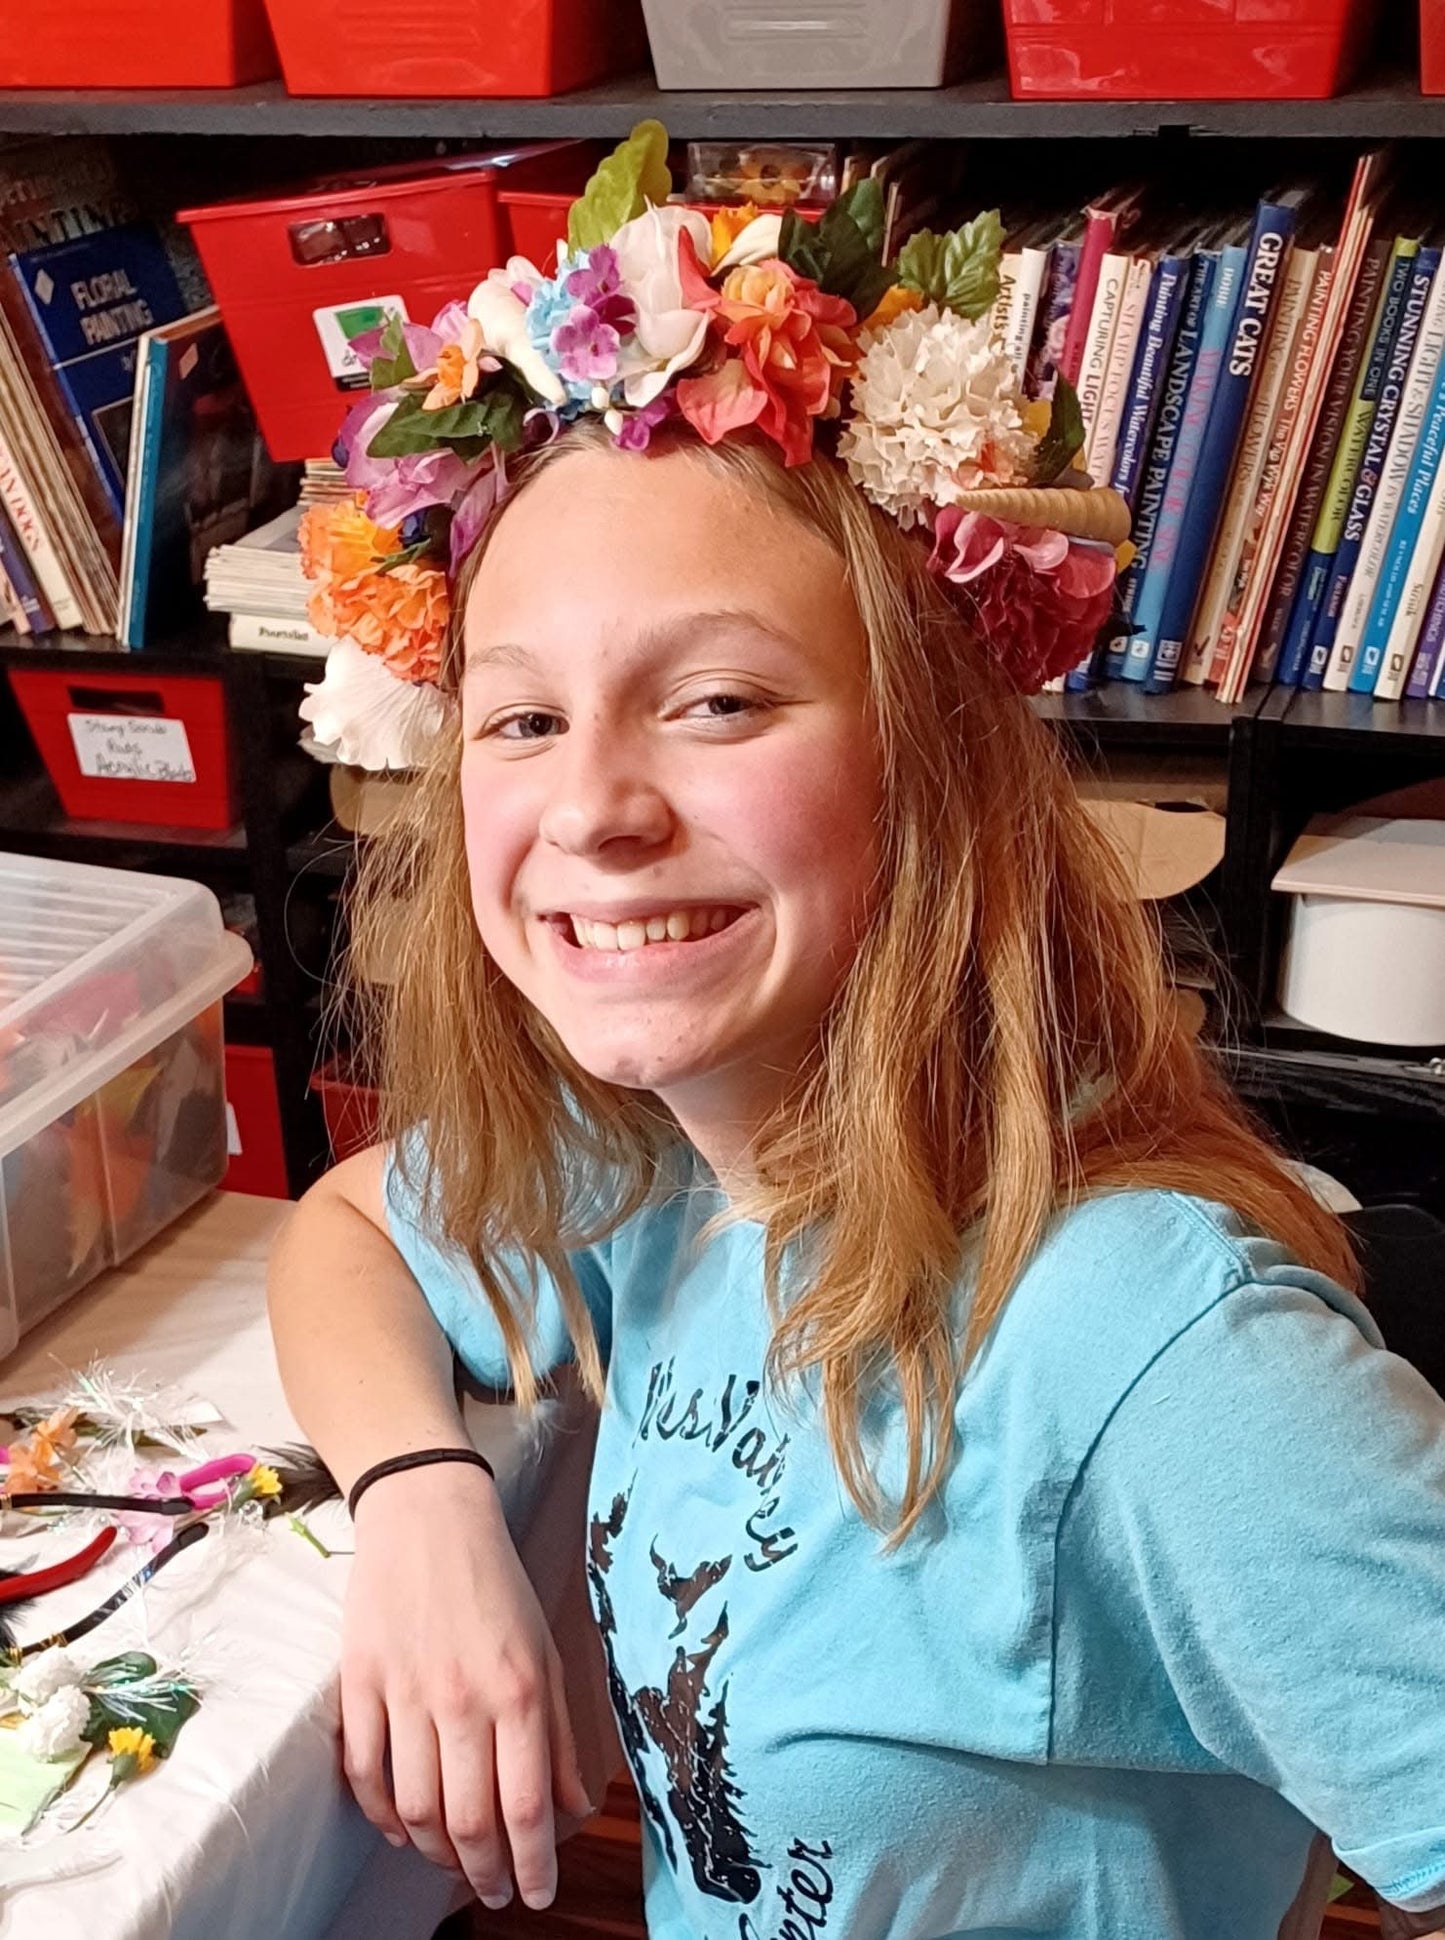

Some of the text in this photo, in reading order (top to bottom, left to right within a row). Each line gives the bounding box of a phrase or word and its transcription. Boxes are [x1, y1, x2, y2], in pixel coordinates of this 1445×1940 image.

[70, 269, 137, 311] FLORAL
[1015, 293, 1031, 342] painting
[1150, 272, 1177, 332] Painting
[1217, 268, 1235, 309] DOBIE
[1229, 233, 1283, 376] GREAT CATS
[1268, 279, 1302, 361] PAINTING
[1303, 270, 1333, 341] PAINTING
[1347, 258, 1381, 343] PAINTING
[80, 298, 154, 345] PAINTING
[1082, 278, 1119, 423] CAPTURING LIGHT
[1114, 304, 1136, 367] SHARP
[1389, 275, 1429, 381] STUNNING
[1136, 335, 1163, 401] Beautiful
[1284, 345, 1313, 412] FLOWERS
[1335, 349, 1357, 395] YOUR
[1415, 331, 1444, 385] LIGHT
[1096, 372, 1123, 431] FOCUS
[1153, 331, 1197, 461] LANDSCAPE
[1332, 263, 1411, 523] TWO BOOKS IN ONE WATERCOLOR
[1119, 405, 1148, 481] Watercolors
[1240, 402, 1270, 481] FLOWERS
[1276, 419, 1294, 440] The
[1316, 400, 1344, 459] VISION
[1364, 385, 1400, 466] CRYSTAL
[1389, 402, 1423, 480] SHADOW
[1421, 405, 1445, 467] Peaceful
[1311, 463, 1326, 482] IN
[1408, 469, 1432, 514] Places
[1132, 467, 1167, 569] PAINTING
[1255, 493, 1273, 518] Way
[1345, 485, 1372, 540] GLASS
[1280, 486, 1320, 596] WATERCOLOR
